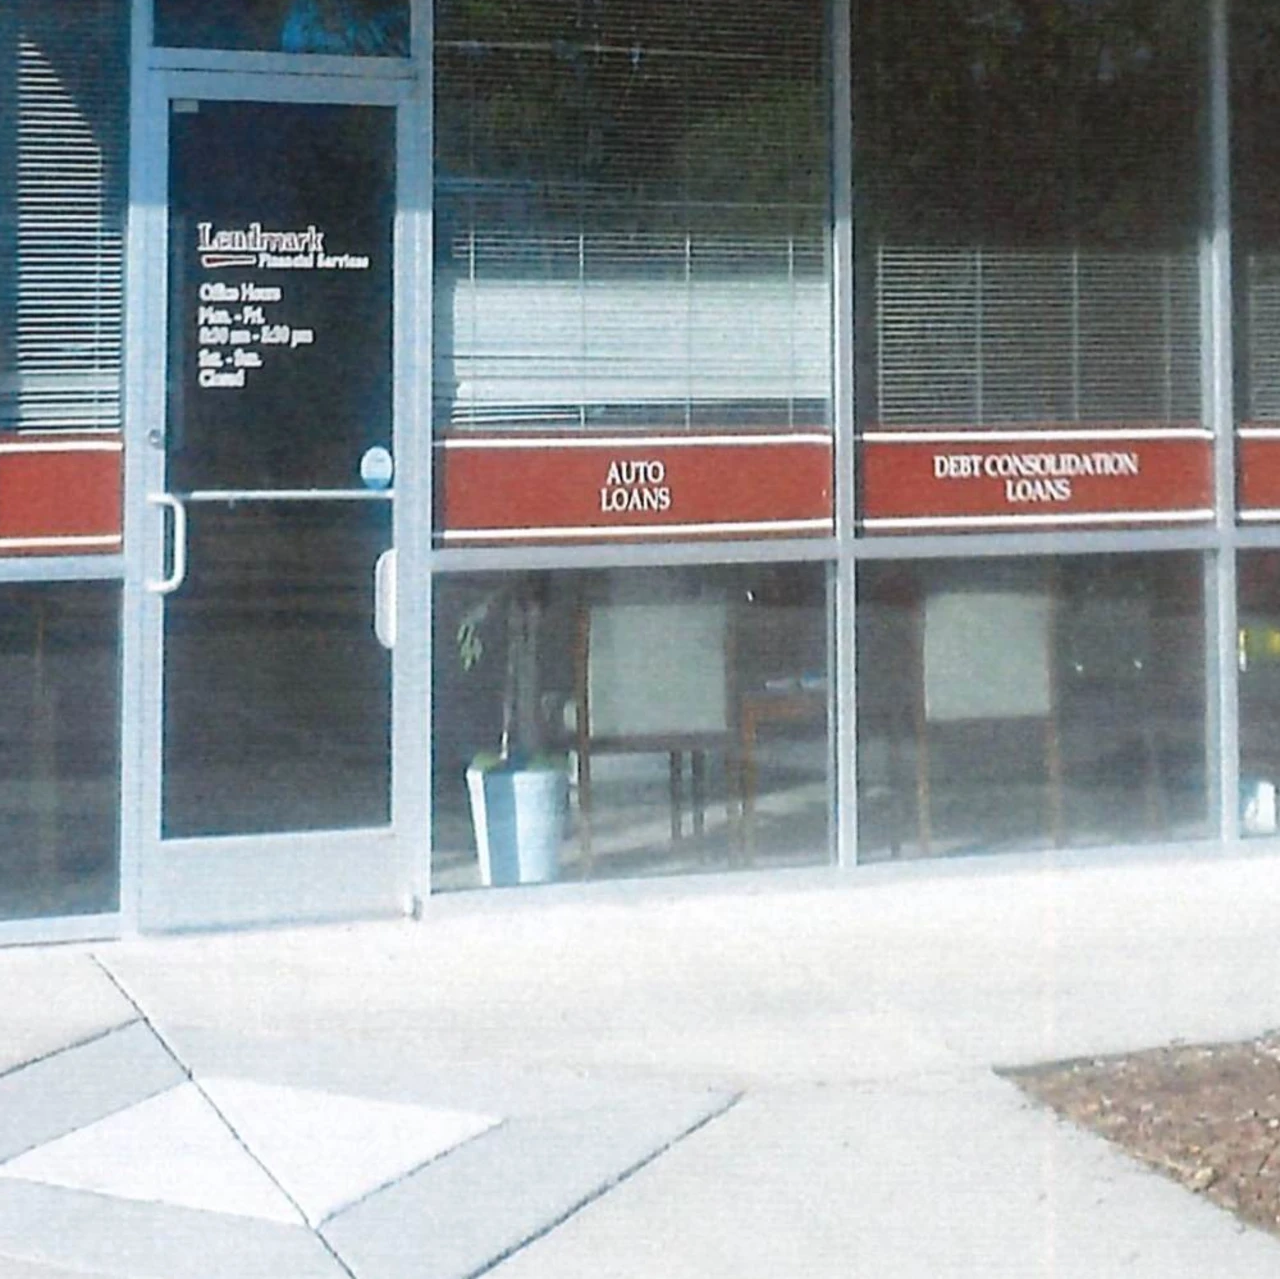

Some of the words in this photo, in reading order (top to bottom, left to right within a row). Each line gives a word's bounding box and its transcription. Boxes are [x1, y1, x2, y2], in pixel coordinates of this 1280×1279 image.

[197, 222, 325, 252] Lendmark
[606, 460, 665, 486] AUTO
[933, 455, 983, 479] DEBT
[984, 452, 1139, 476] CONSOLIDATION
[600, 487, 671, 512] LOANS
[1005, 478, 1072, 503] LOANS
